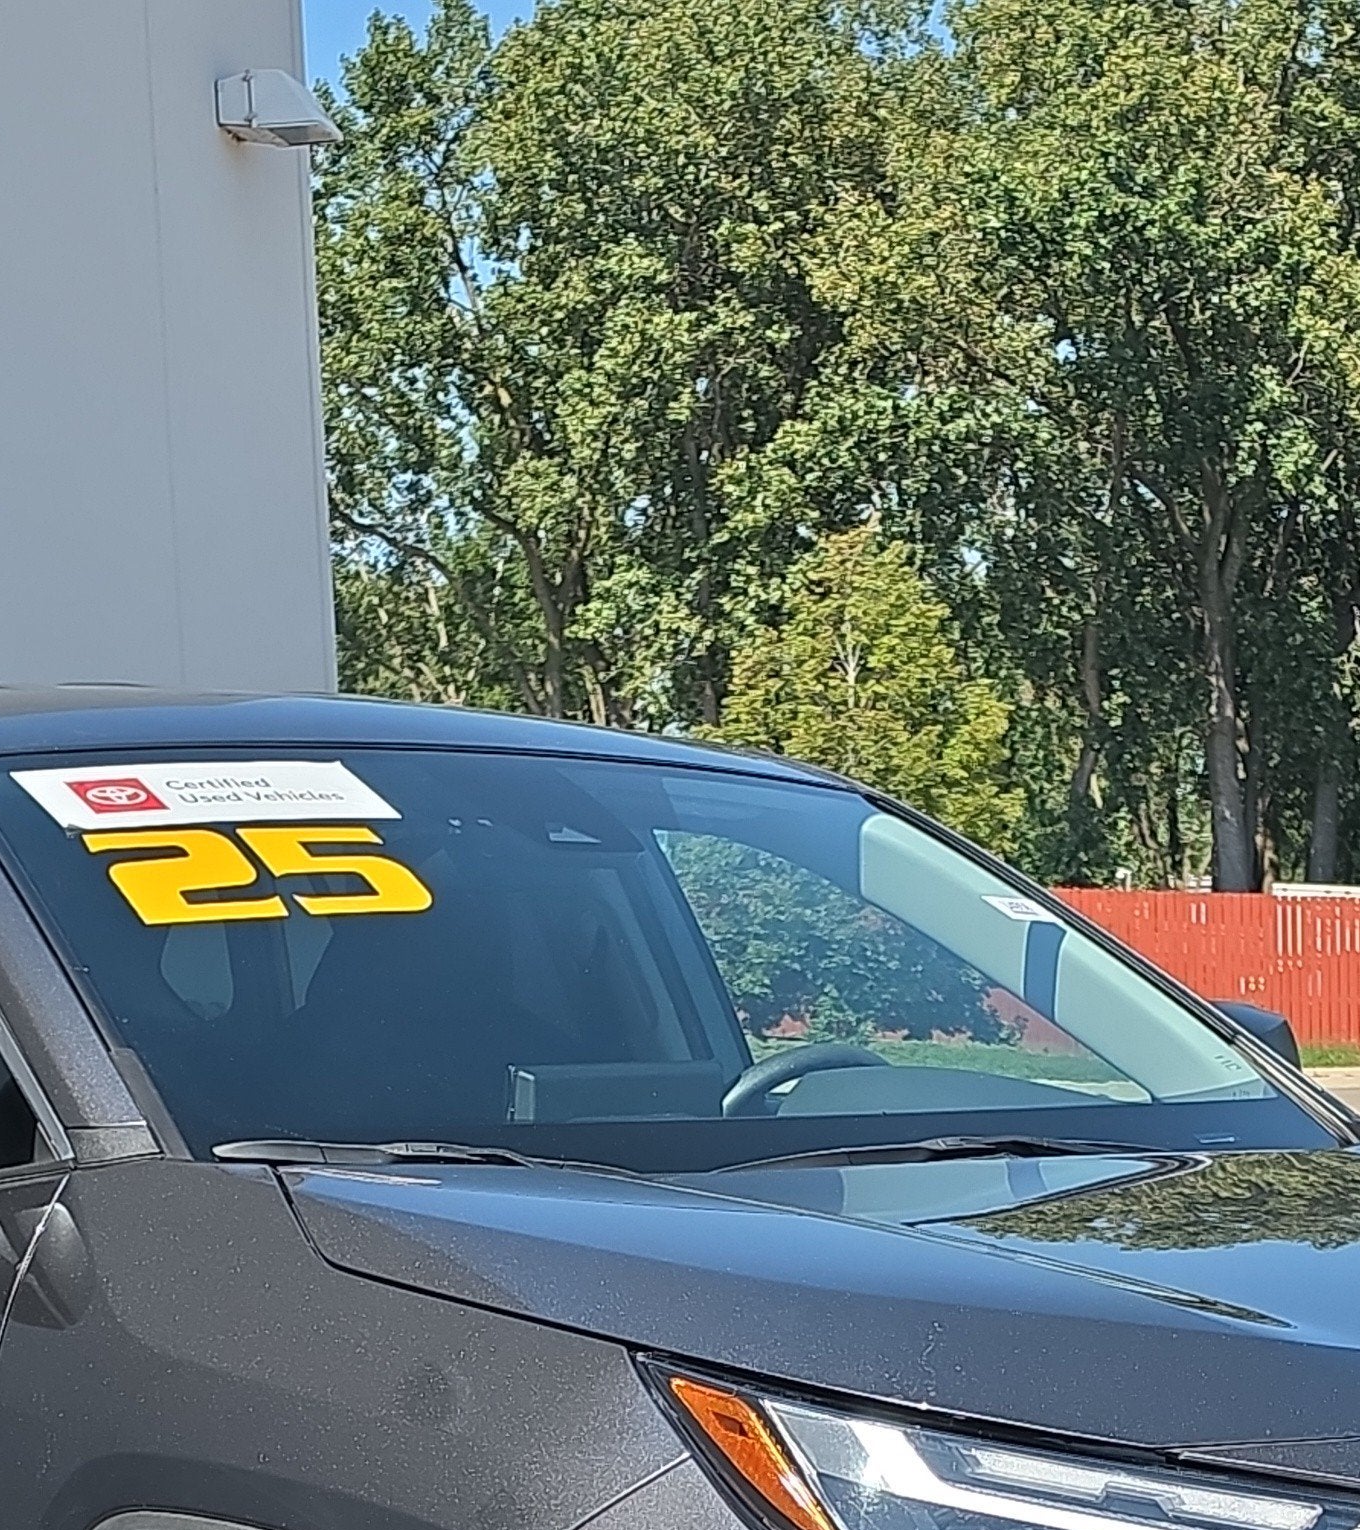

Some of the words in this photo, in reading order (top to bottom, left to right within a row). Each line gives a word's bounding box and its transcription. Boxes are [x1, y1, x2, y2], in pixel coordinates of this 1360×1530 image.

[164, 776, 272, 791] Certified
[178, 790, 242, 805] Used
[248, 788, 346, 804] Vehicles
[80, 825, 435, 926] 25
